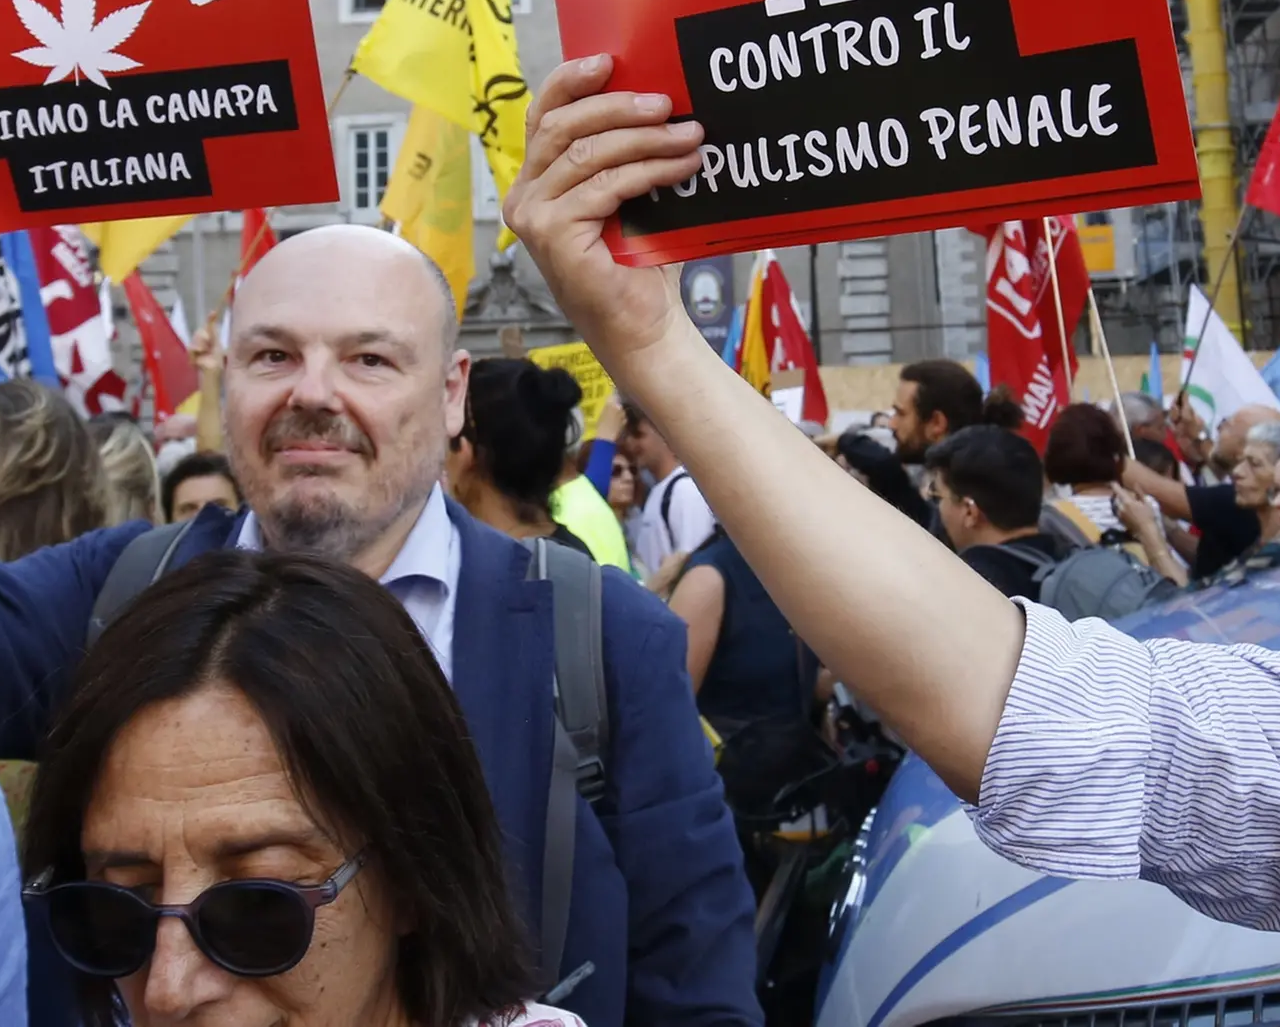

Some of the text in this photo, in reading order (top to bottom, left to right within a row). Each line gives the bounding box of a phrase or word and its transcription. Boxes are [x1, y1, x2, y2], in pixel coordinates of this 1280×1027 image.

[709, 1, 972, 92] CONTRO IL
[98, 97, 138, 128] LA
[146, 84, 278, 124] CANAPA
[29, 152, 192, 194] ITALIANA
[650, 83, 1119, 202] PULISMO PENALE
